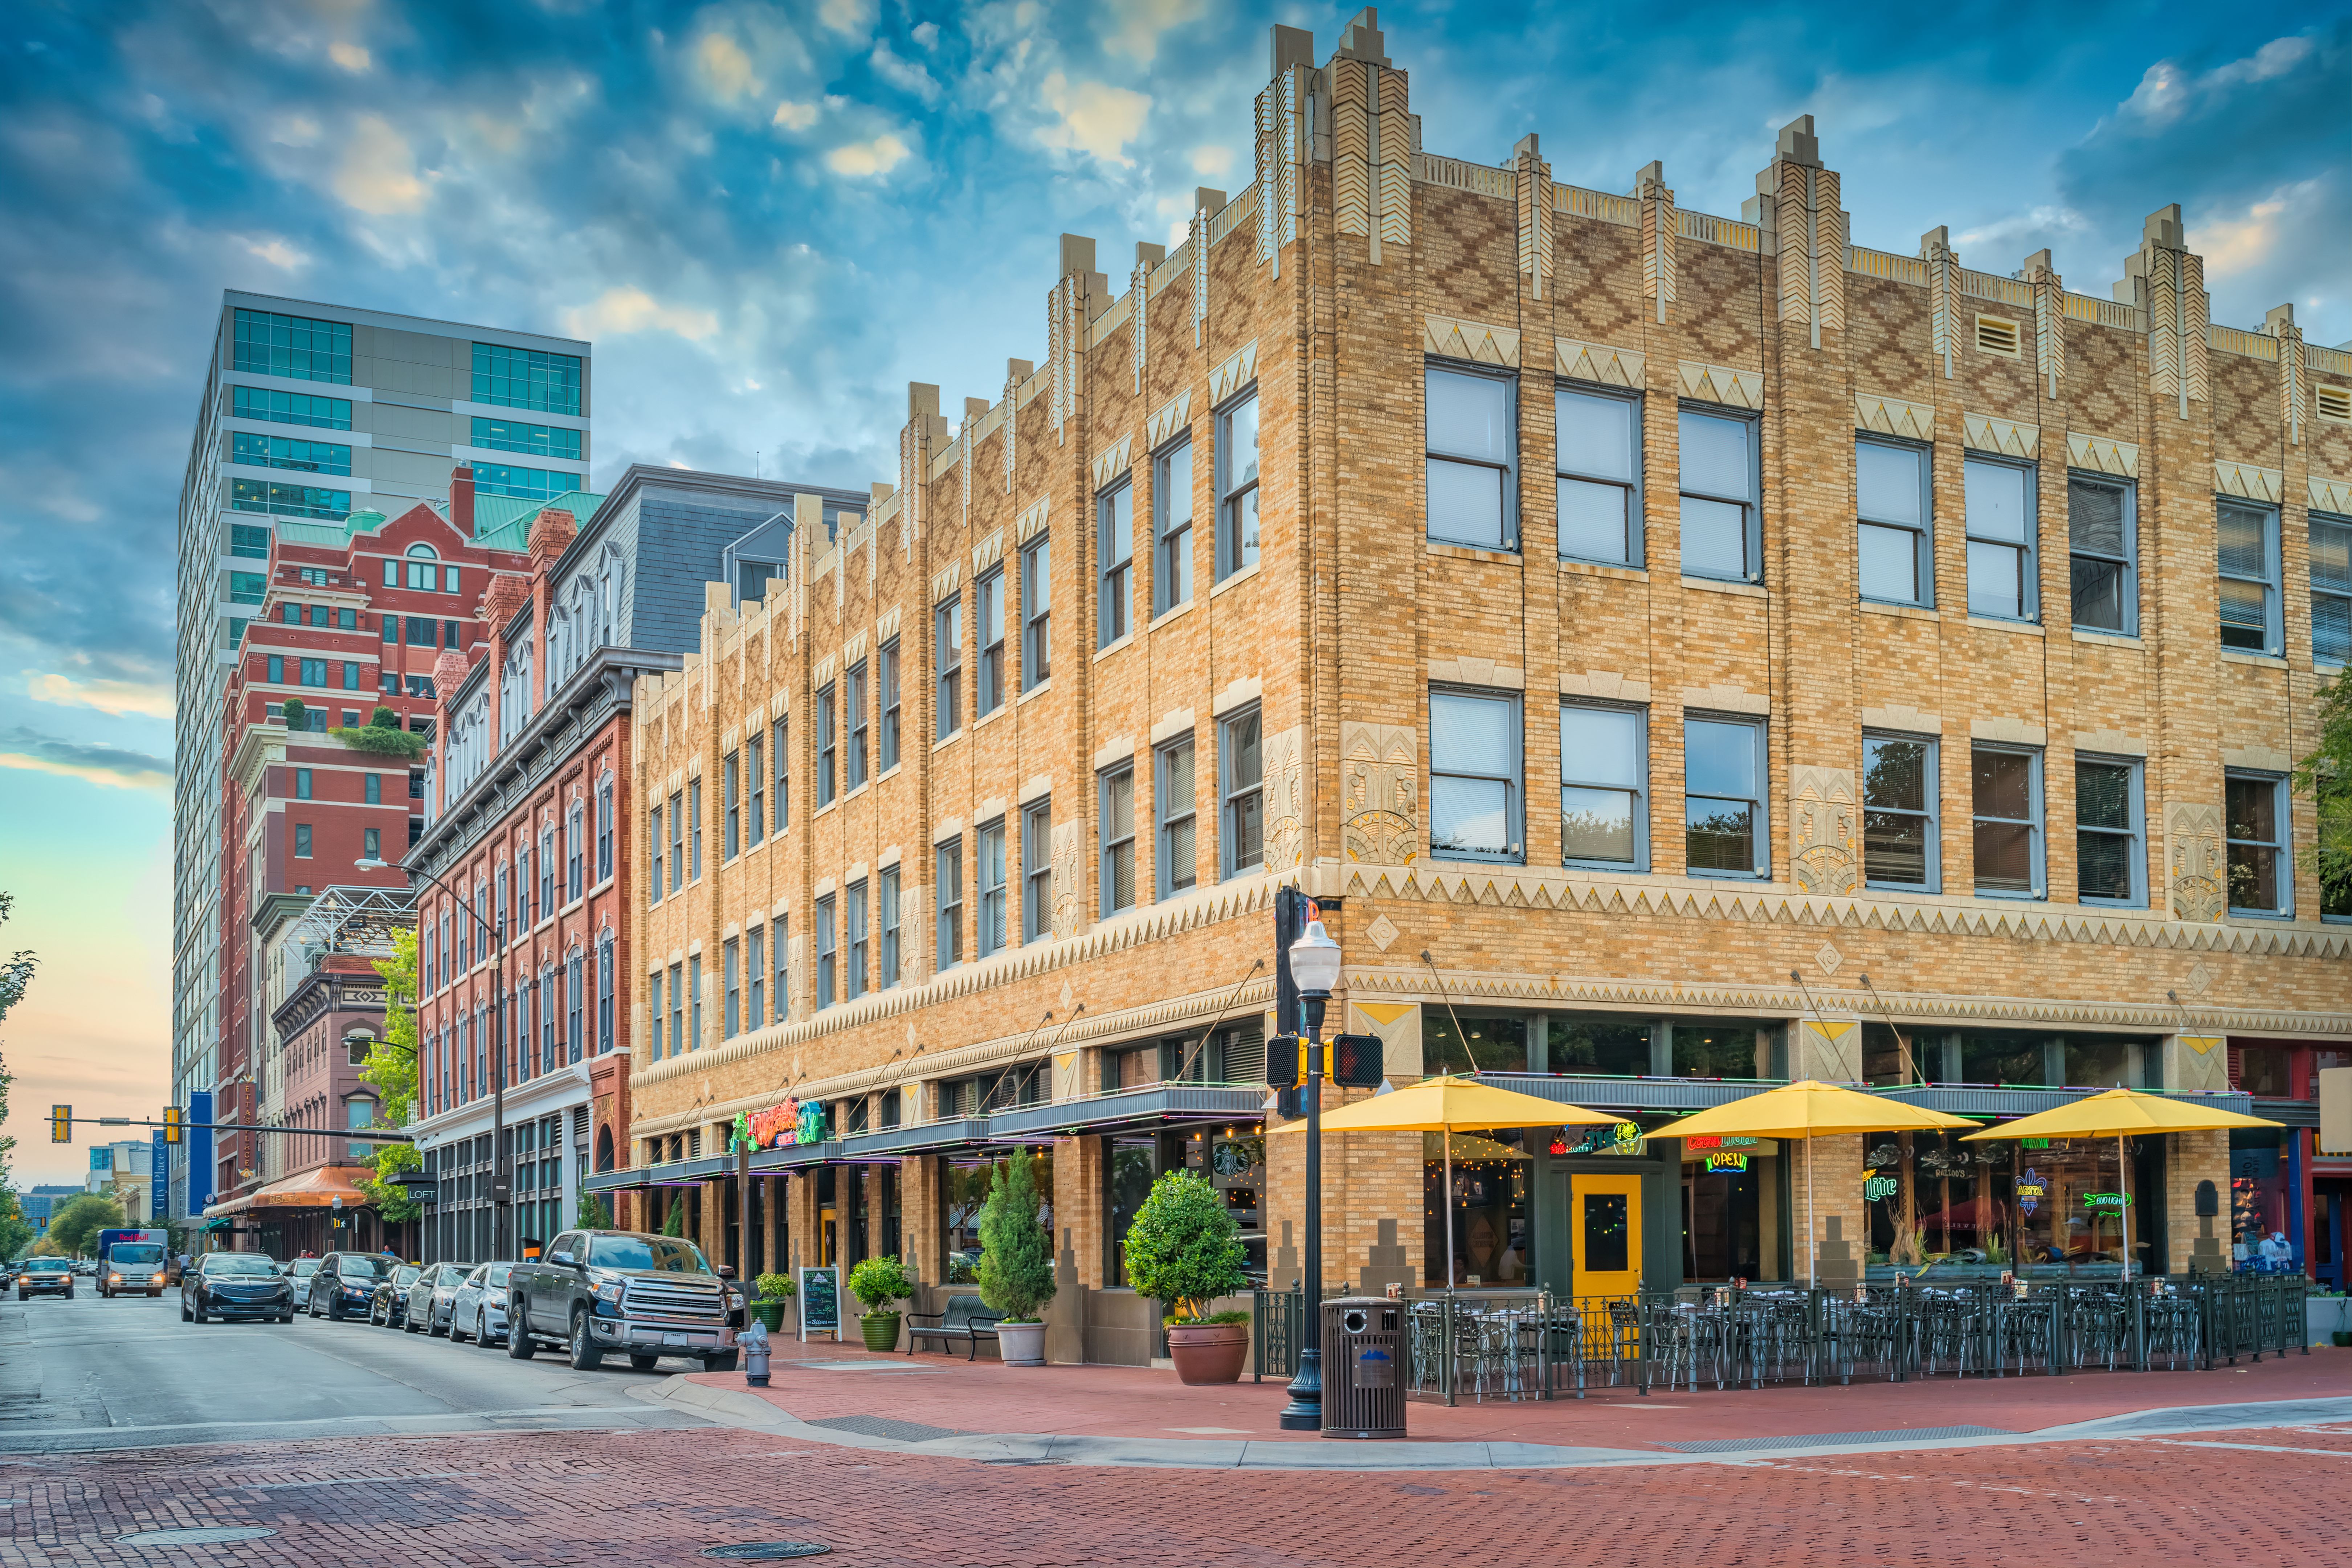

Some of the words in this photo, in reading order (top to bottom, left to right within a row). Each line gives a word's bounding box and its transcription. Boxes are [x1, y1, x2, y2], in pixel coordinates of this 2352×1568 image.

[1712, 1153, 1742, 1166] OPEN
[154, 1153, 165, 1182] Place
[1935, 1169, 1965, 1177] RAZZOO'S
[1865, 1177, 1897, 1201] Lite
[2017, 1185, 2043, 1196] ABITA
[154, 1188, 167, 1209] City
[269, 1193, 301, 1204] REATA
